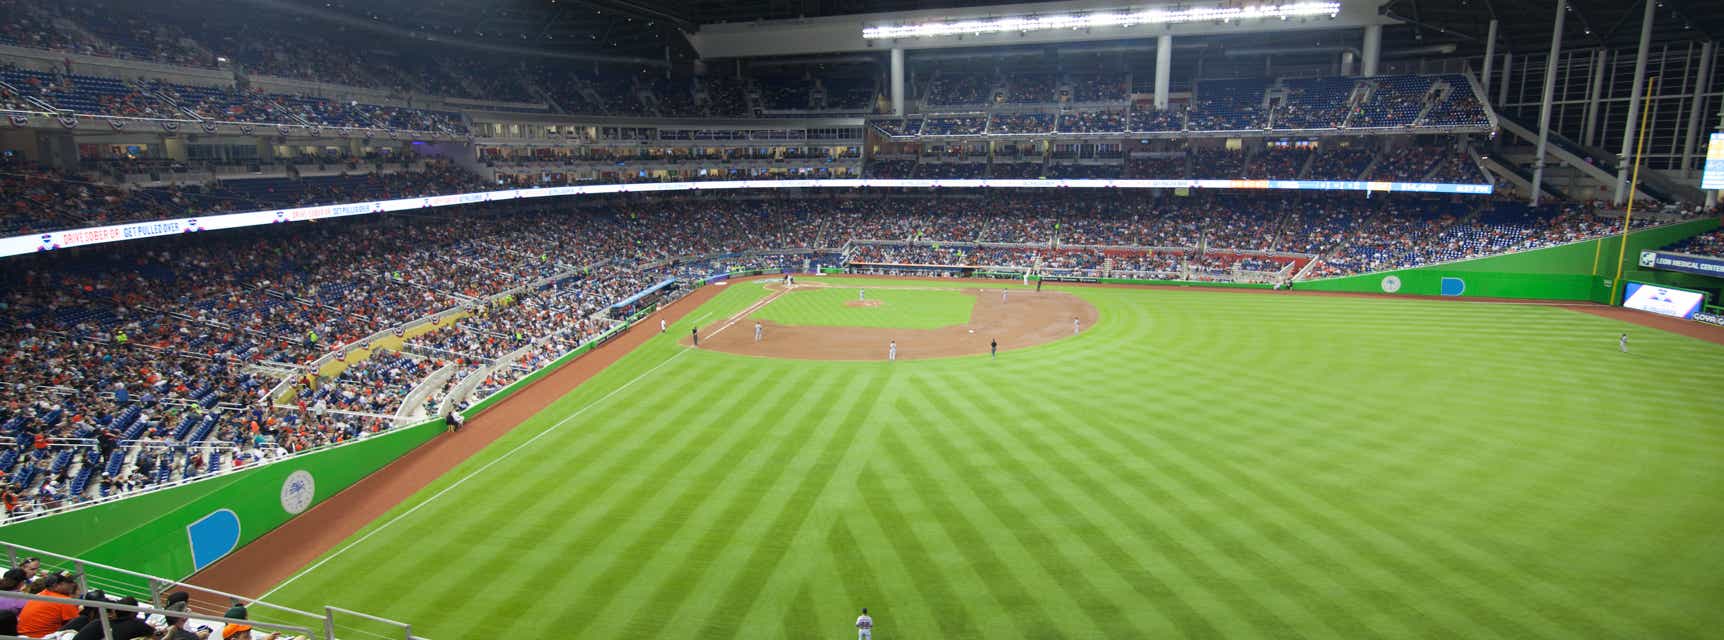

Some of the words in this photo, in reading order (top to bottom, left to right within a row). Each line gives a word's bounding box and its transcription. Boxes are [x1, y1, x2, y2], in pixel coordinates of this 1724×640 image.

[85, 230, 107, 242] SOBER
[123, 226, 136, 237] GET
[138, 223, 161, 235] PULLED
[163, 222, 179, 233] OVER
[1672, 260, 1699, 269] MEDICAL
